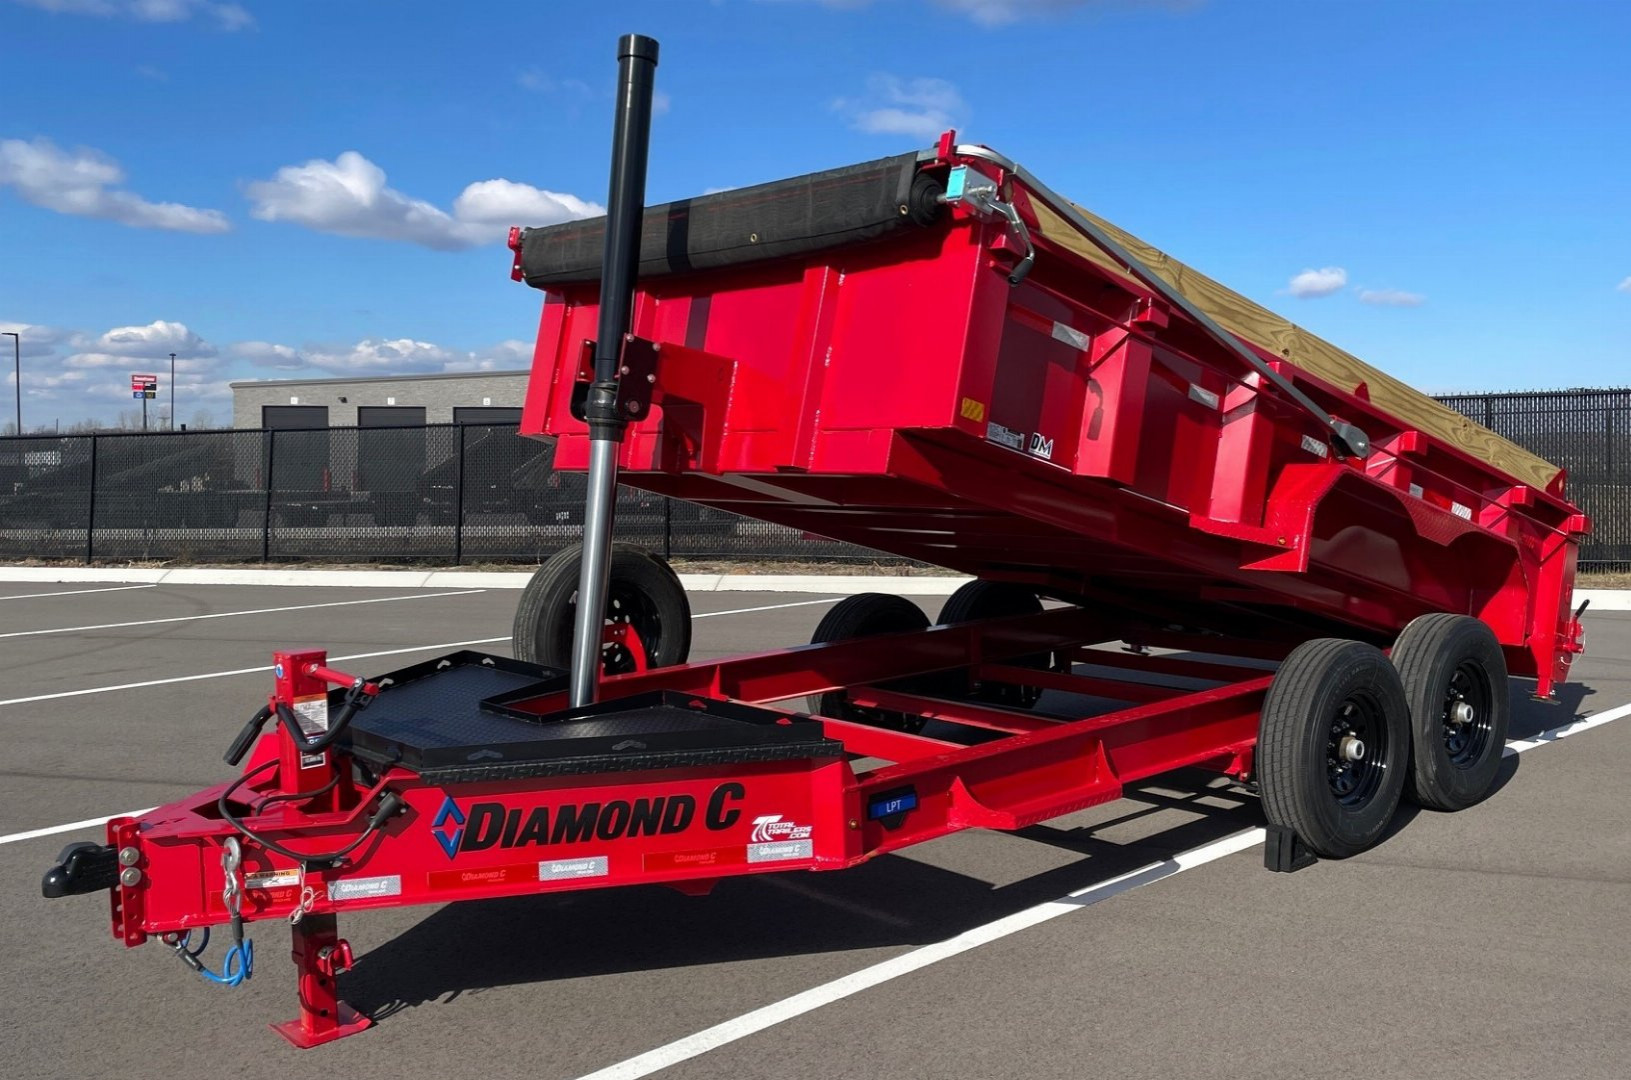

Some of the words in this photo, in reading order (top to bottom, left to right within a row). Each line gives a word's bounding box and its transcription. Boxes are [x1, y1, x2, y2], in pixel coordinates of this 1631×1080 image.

[1030, 433, 1053, 457] DM
[886, 800, 901, 812] LPT
[460, 795, 696, 852] DIAMOND
[705, 782, 745, 831] C
[768, 822, 796, 830] TOTAL
[556, 863, 588, 873] DIAMOND
[588, 861, 596, 869] C
[466, 872, 498, 881] DIAMOND
[500, 870, 507, 878] C
[380, 880, 388, 889] C
